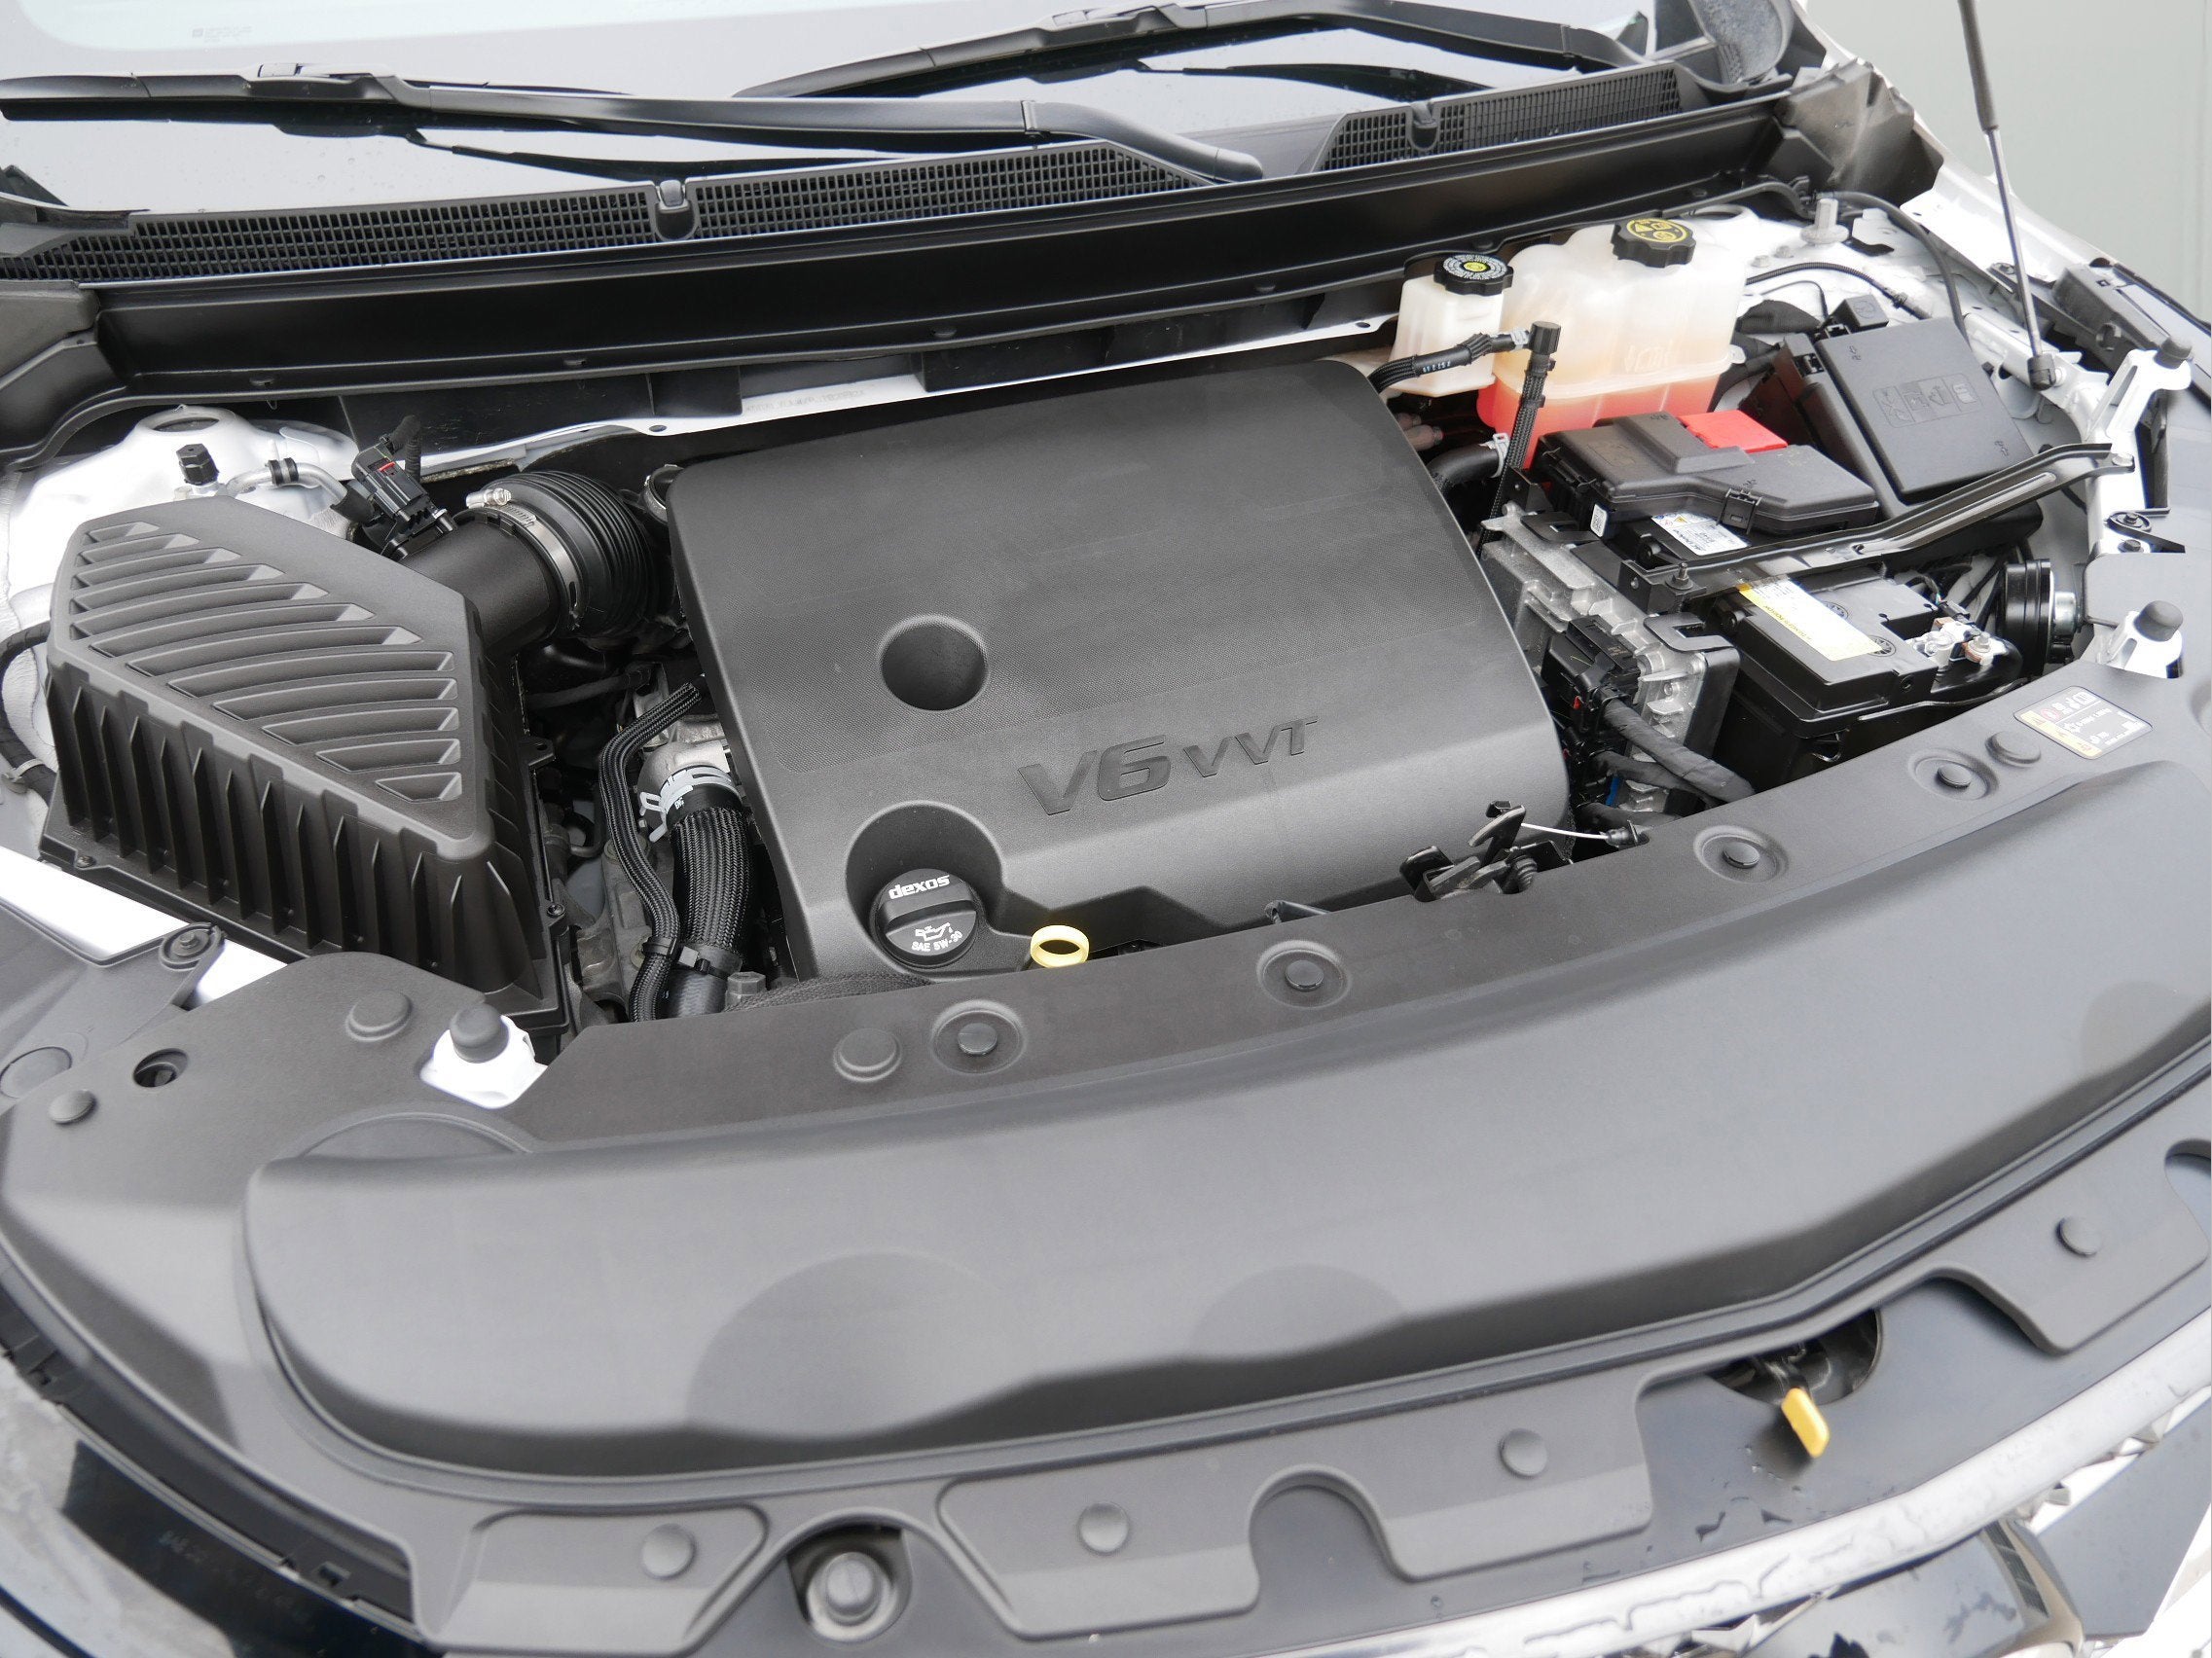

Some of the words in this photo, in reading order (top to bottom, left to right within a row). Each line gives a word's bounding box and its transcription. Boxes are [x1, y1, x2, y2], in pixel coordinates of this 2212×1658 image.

[1018, 734, 1171, 815] V6
[1182, 714, 1319, 777] VVT
[888, 875, 950, 900] dexos
[911, 941, 931, 952] SAE
[933, 930, 963, 951] 5W-30
